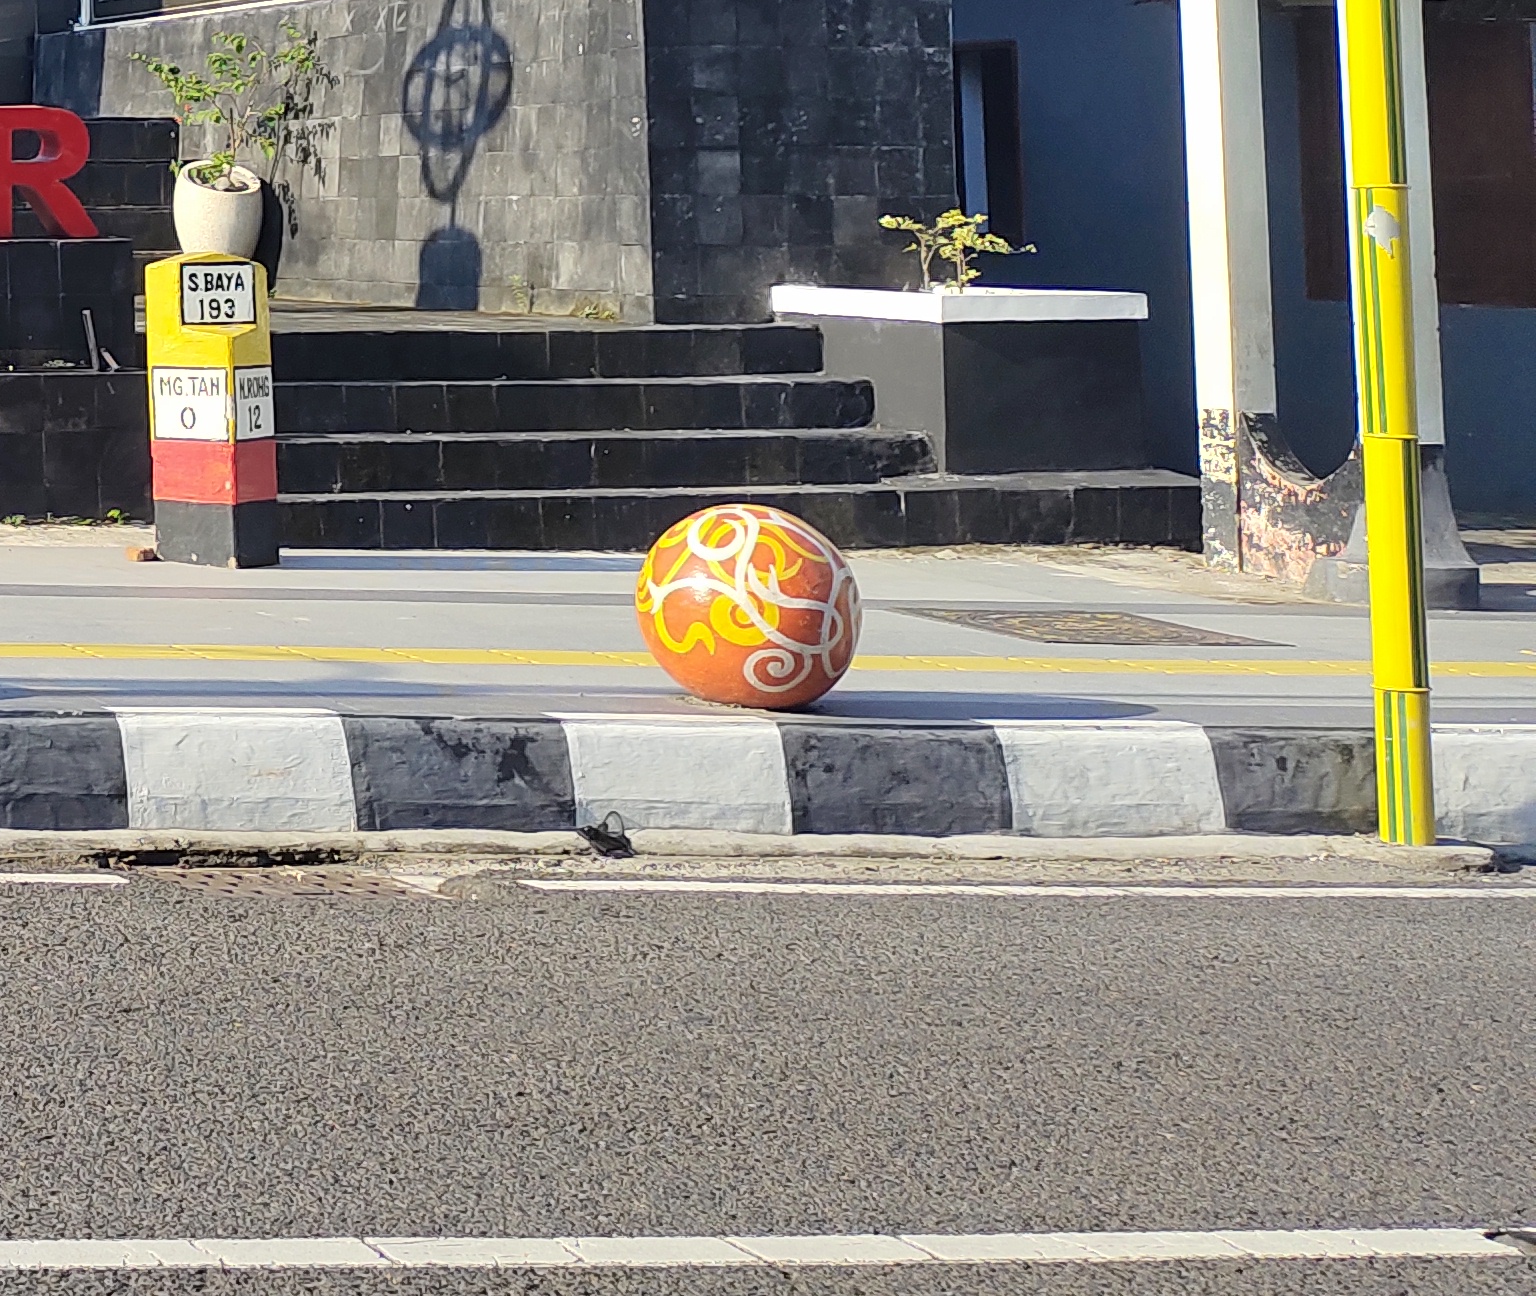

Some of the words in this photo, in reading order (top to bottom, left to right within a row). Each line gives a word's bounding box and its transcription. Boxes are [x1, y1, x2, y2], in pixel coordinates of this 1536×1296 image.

[188, 272, 245, 292] S.BAYA
[198, 298, 236, 320] 193
[180, 406, 196, 429] 0
[248, 404, 262, 433] 12
